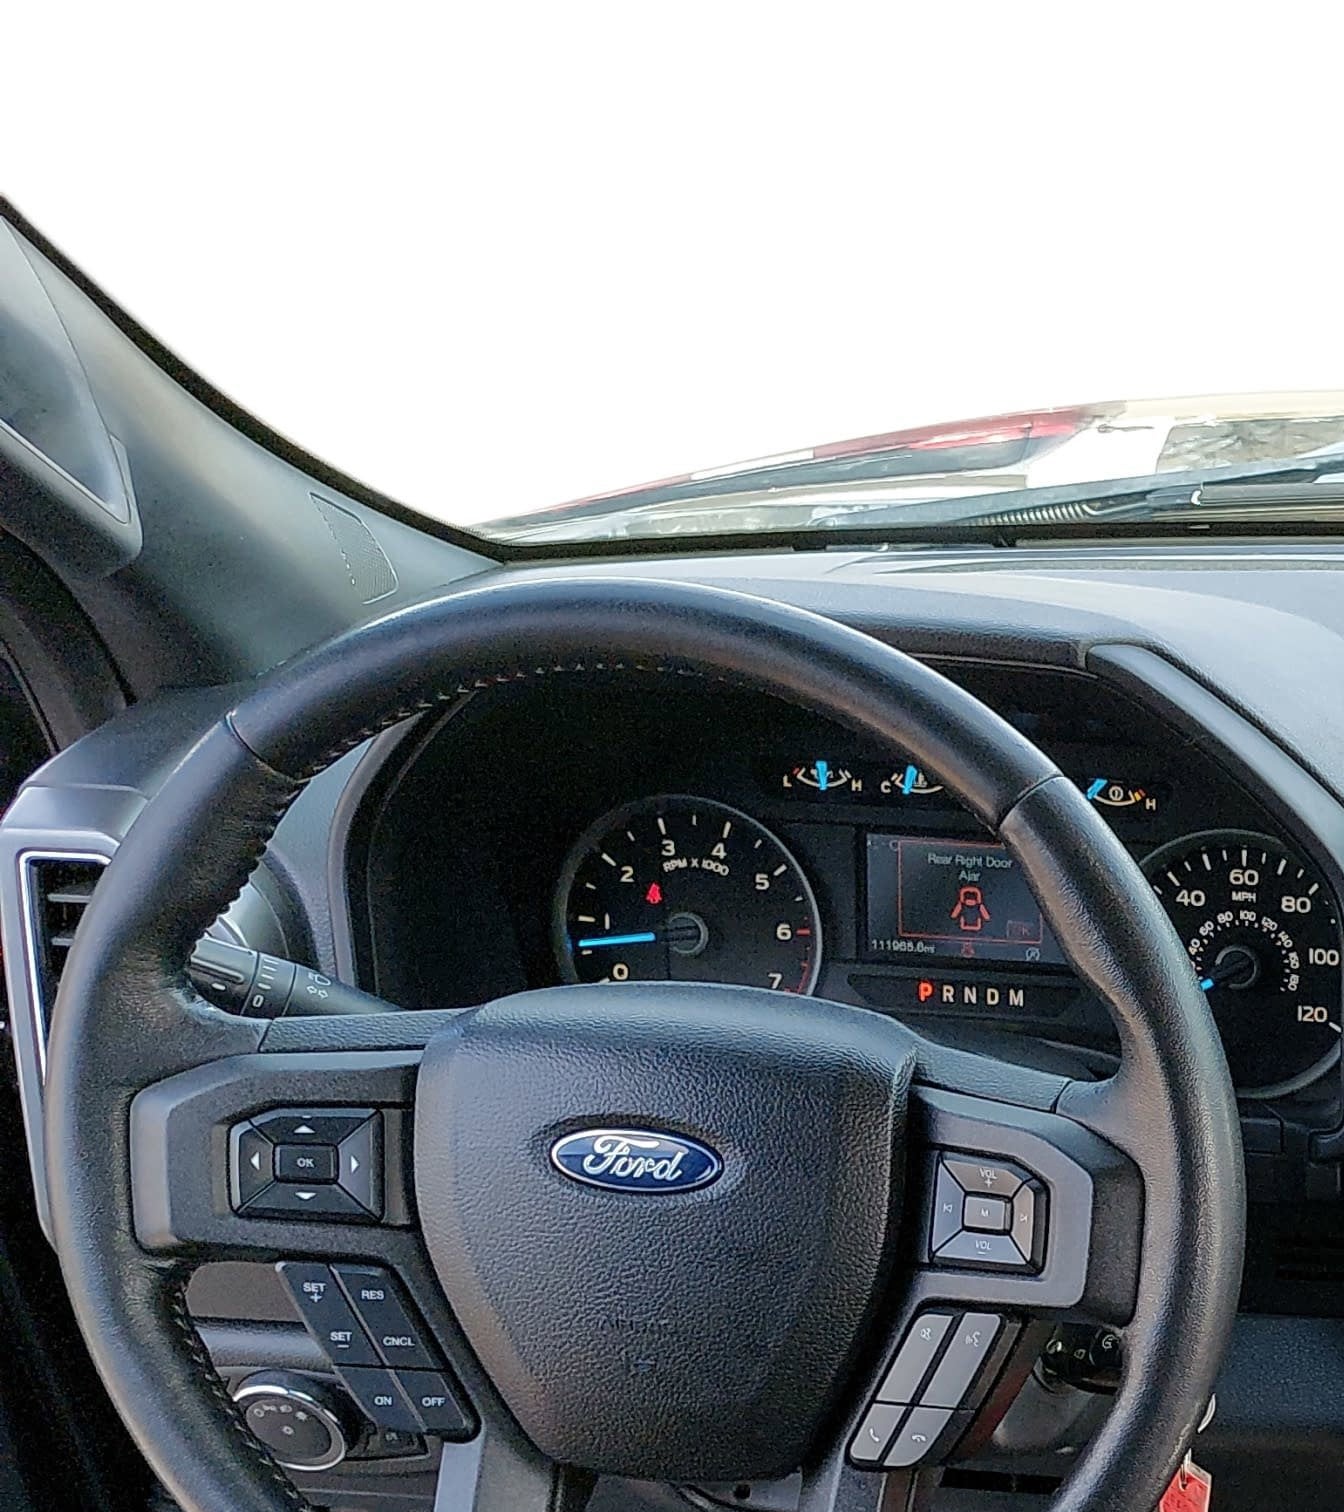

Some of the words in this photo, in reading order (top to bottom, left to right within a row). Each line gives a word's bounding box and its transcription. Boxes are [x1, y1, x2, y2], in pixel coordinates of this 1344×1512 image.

[851, 780, 863, 793] H
[880, 781, 892, 794] C
[1144, 797, 1157, 811] H
[661, 839, 676, 857] 3
[711, 842, 728, 860] 4
[662, 858, 689, 874] RPM
[701, 858, 730, 877] 1000
[927, 852, 953, 866] Rear
[954, 855, 984, 869] Right
[985, 855, 1013, 869] Door
[620, 866, 635, 883] 2
[755, 873, 771, 890] 5
[958, 870, 982, 883] Ajar
[1229, 869, 1259, 886] 60
[1176, 889, 1206, 907] 40
[1231, 891, 1257, 903] MPH
[1280, 896, 1312, 913] 80
[603, 912, 612, 931] 1
[1239, 910, 1257, 922] 100
[776, 923, 792, 941] 6
[1308, 948, 1340, 966] 100
[612, 962, 630, 981] 0
[767, 972, 783, 989] 7
[918, 982, 934, 1002] P
[942, 985, 955, 1003] R
[964, 986, 977, 1004] N
[986, 988, 999, 1005] D
[1008, 988, 1024, 1008] M
[1296, 1005, 1328, 1023] 120
[296, 1157, 315, 1169] OK
[583, 1133, 683, 1183] Ford
[979, 1167, 997, 1180] VOL
[975, 1239, 991, 1250] VOL
[303, 1282, 327, 1293] SET
[361, 1290, 384, 1300] RES
[330, 1331, 352, 1342] SET
[383, 1336, 415, 1347] CNCL
[374, 1396, 392, 1406] ON
[421, 1396, 445, 1408] OFF
